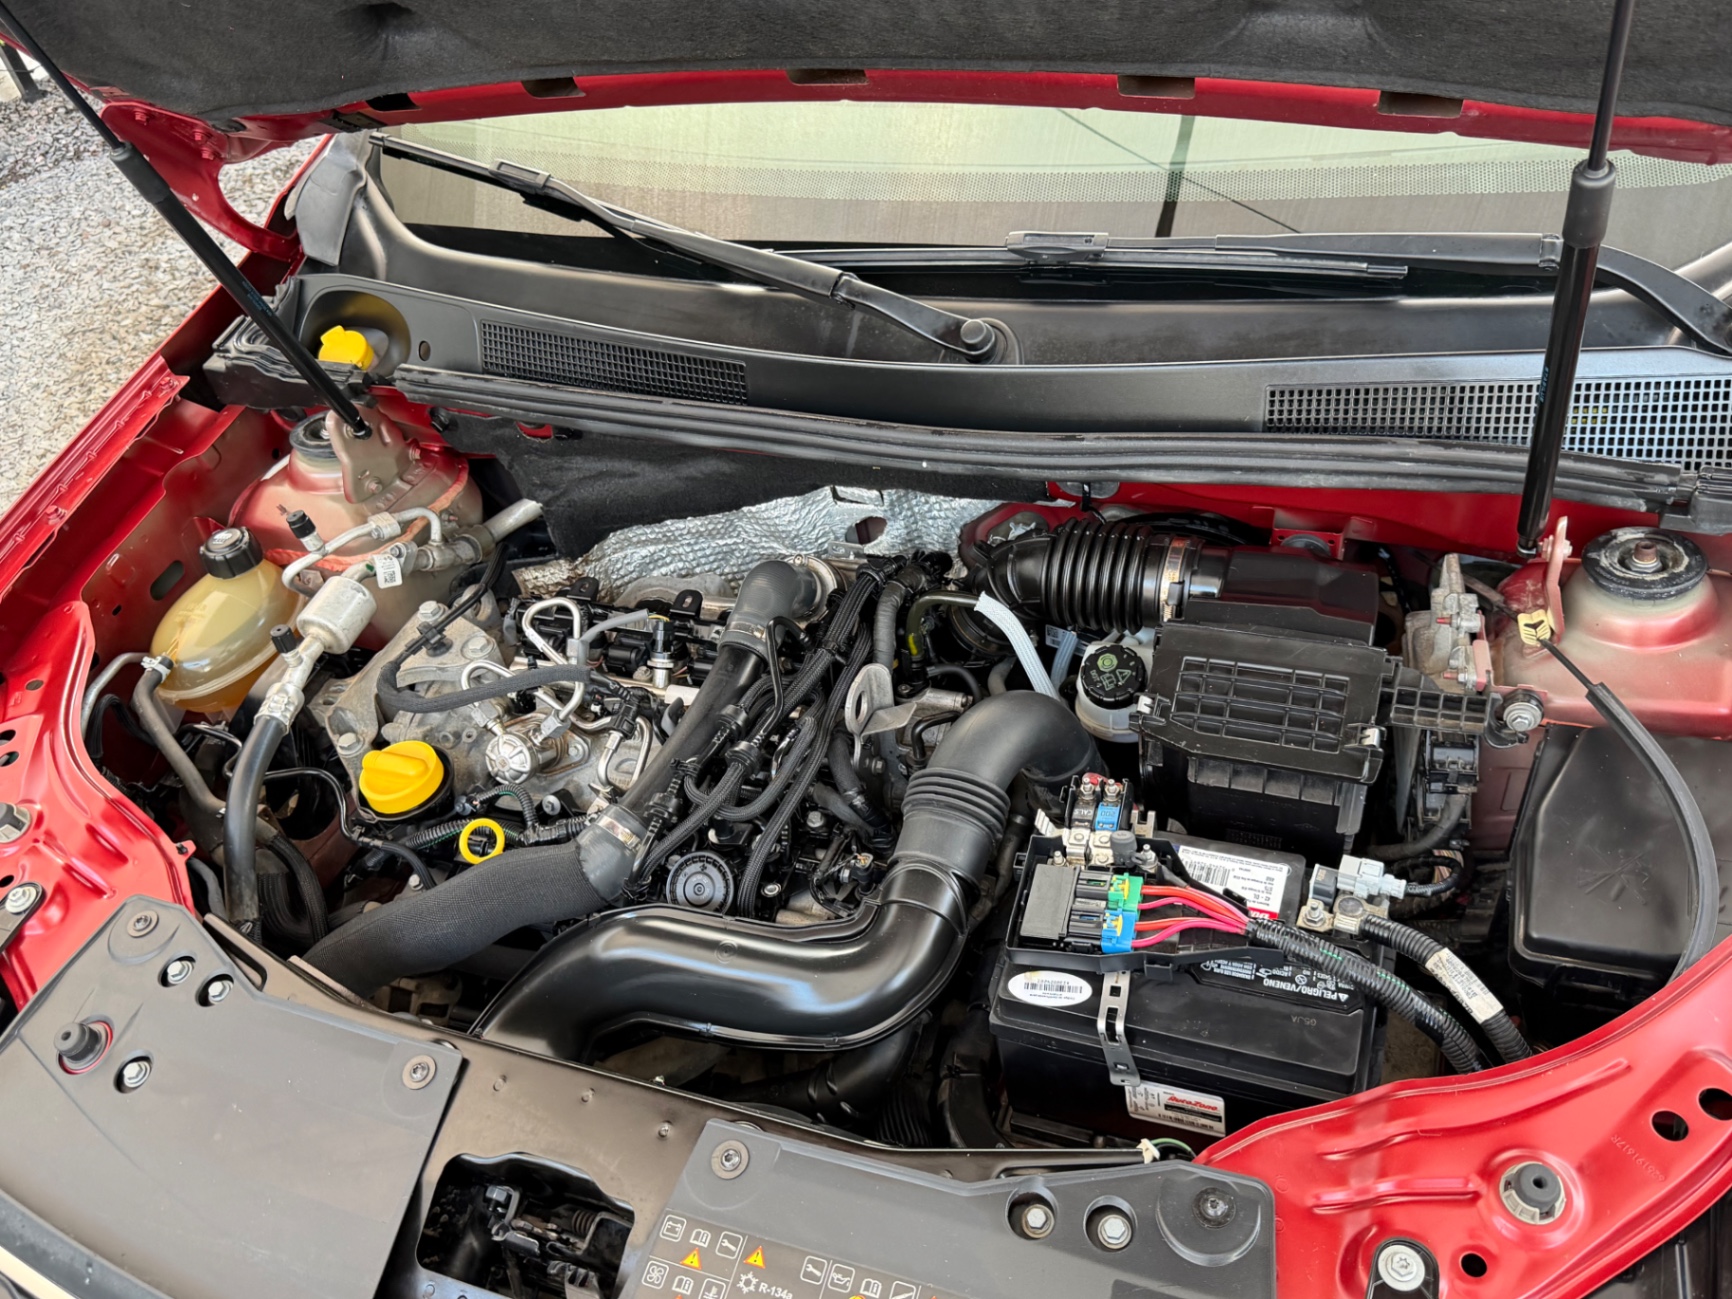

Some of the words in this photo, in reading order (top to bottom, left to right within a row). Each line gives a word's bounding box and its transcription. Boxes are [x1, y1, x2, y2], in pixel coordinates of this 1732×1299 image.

[1262, 977, 1338, 1001] PELIGRO/VENENO
[1167, 1094, 1219, 1112] AutoZone
[758, 1282, 793, 1299] R-134a
